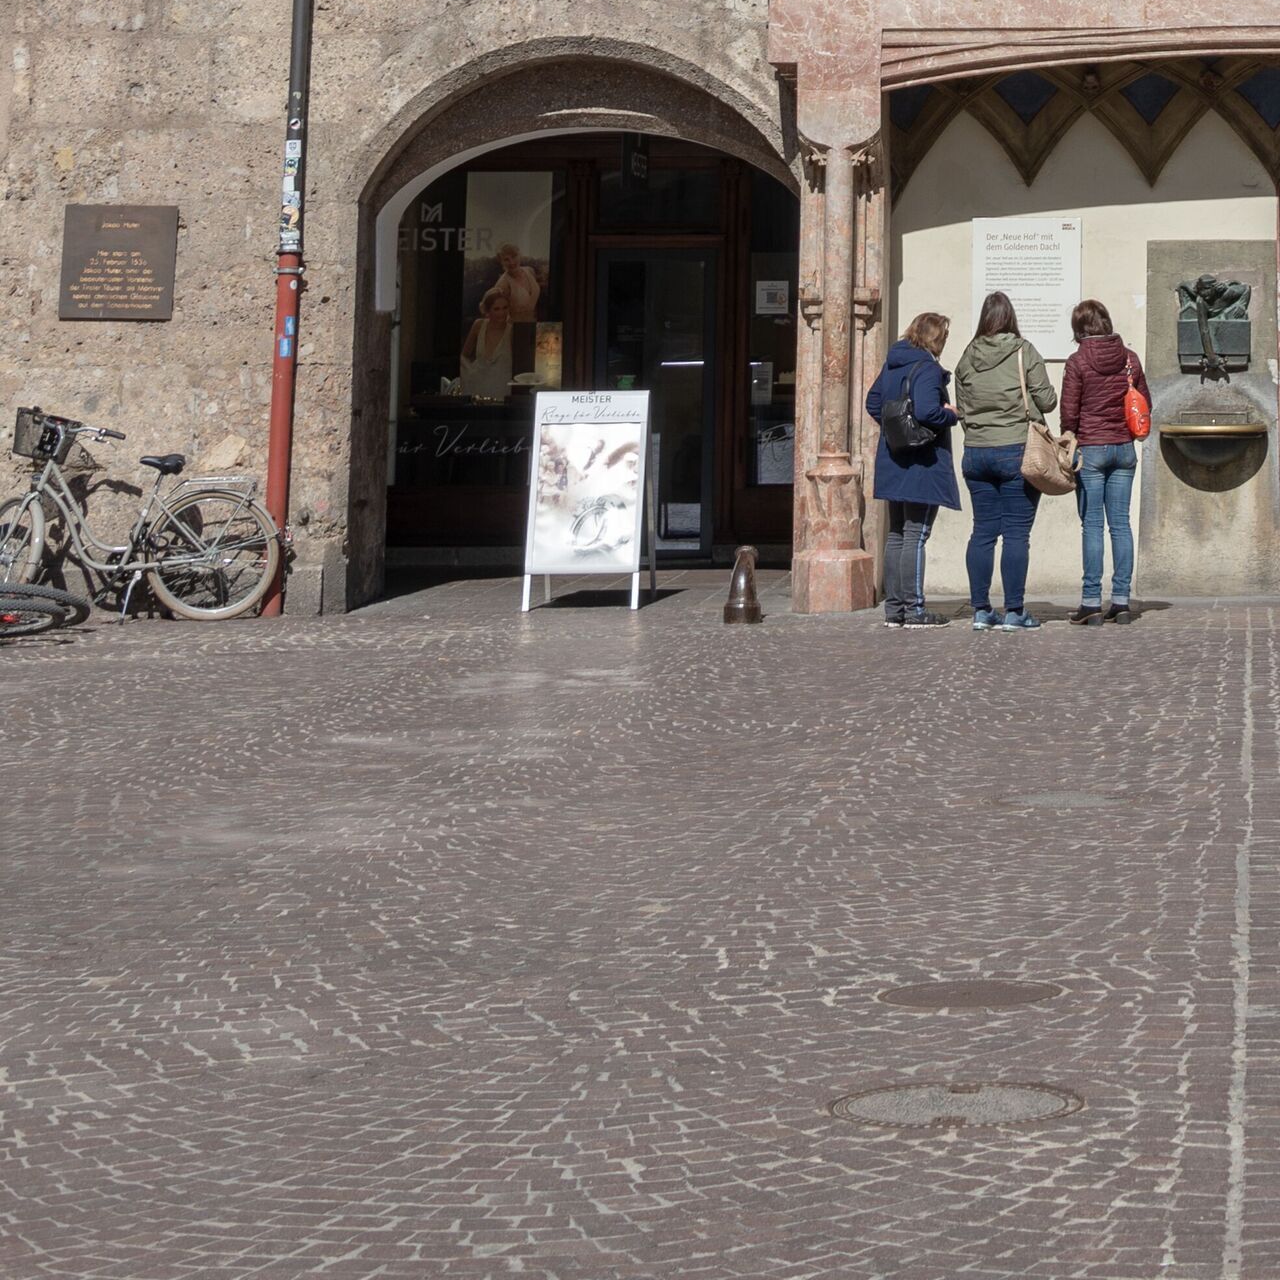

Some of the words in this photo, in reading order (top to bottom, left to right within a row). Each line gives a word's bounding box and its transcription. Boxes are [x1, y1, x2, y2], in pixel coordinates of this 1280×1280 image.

[398, 228, 493, 252] EISTER
[986, 233, 999, 241] Der
[1041, 233, 1054, 241] mit
[986, 242, 1002, 251] dem
[1004, 242, 1038, 251] Goldenen
[1040, 242, 1060, 251] Dachl
[571, 395, 612, 404] MEISTER
[433, 424, 531, 458] Verlieb
